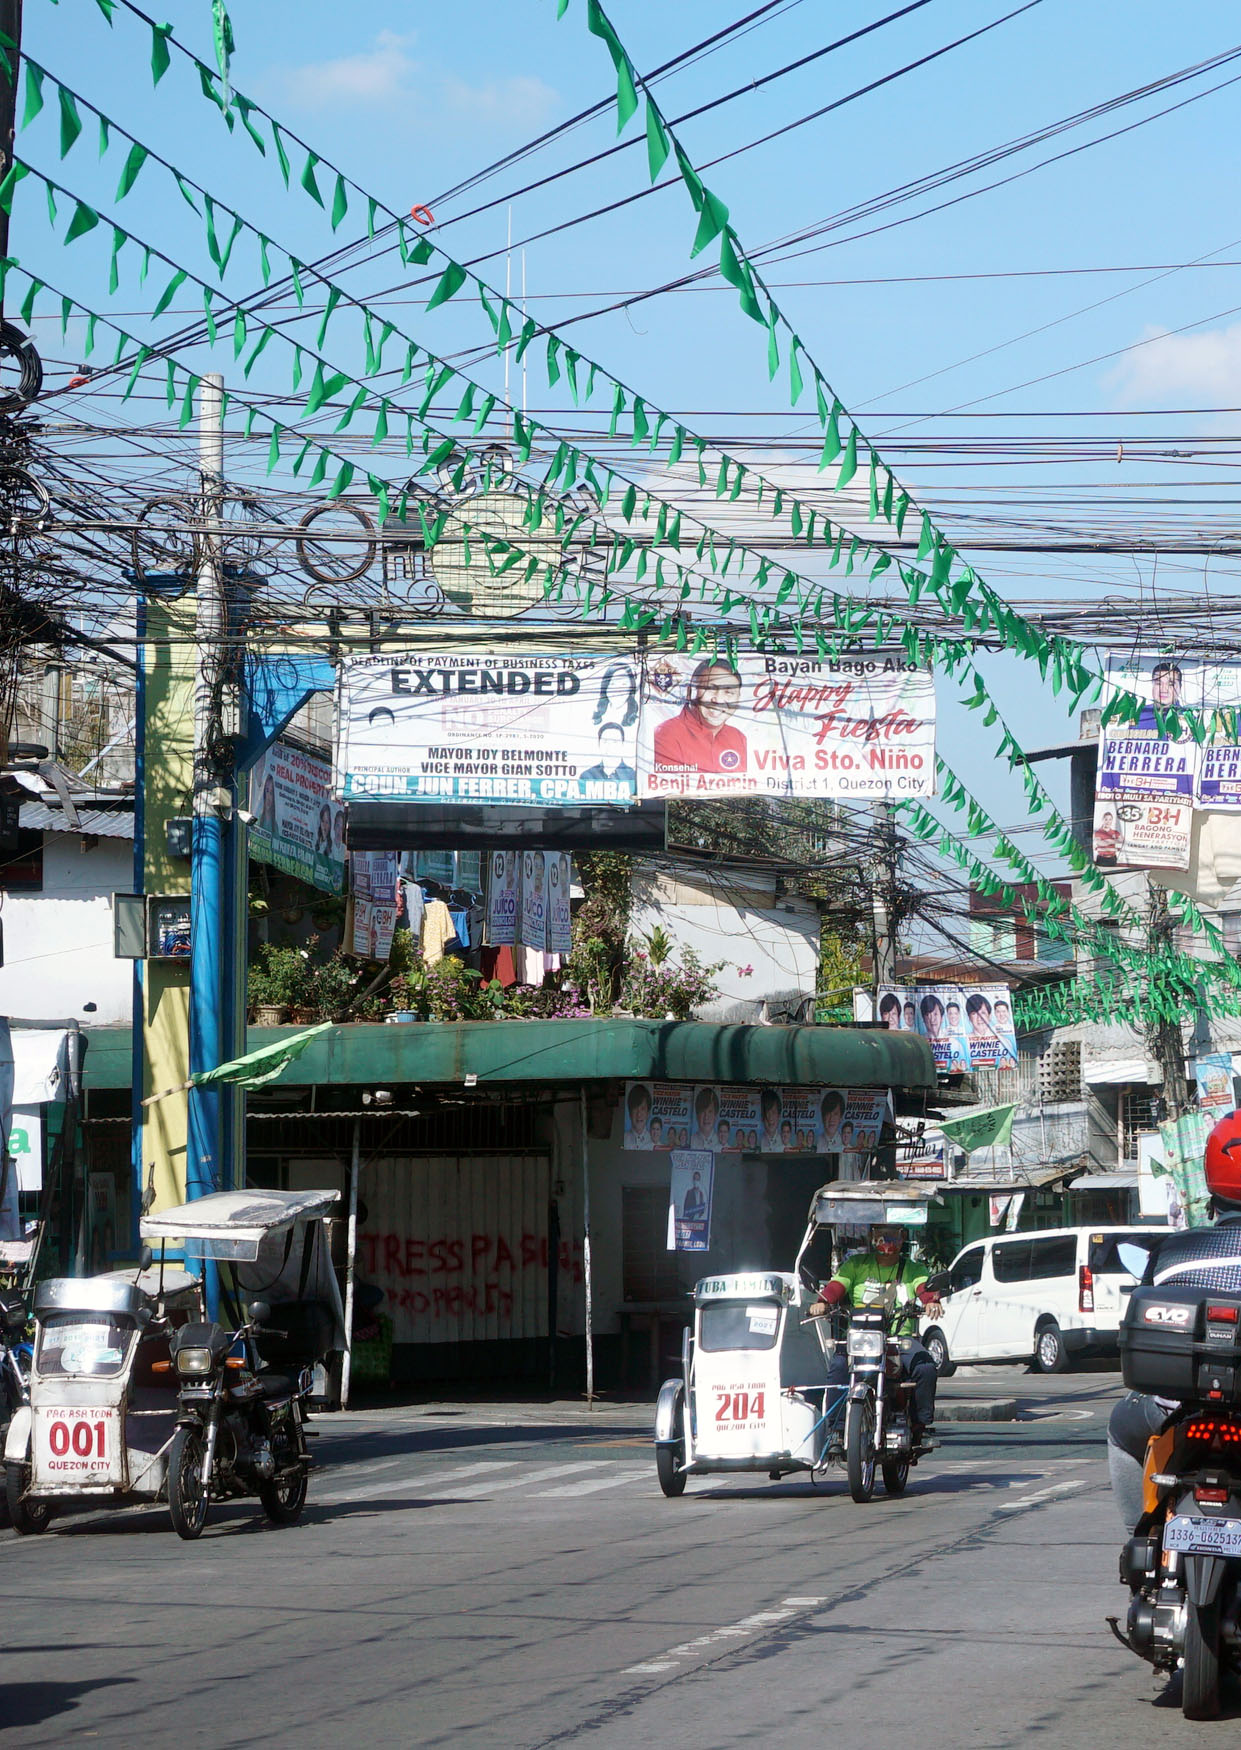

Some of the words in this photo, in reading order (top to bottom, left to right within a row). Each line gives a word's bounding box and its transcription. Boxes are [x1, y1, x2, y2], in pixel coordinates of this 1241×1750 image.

[411, 658, 422, 668] OF
[428, 657, 480, 668] PAYMENT
[485, 658, 499, 669] OF
[502, 659, 557, 670] BUSINESS
[562, 660, 596, 671] TAXES
[764, 658, 822, 677] Bayan
[829, 658, 878, 677] Bago
[882, 658, 918, 674] Ako
[391, 668, 580, 696] EXTENDED
[752, 678, 856, 713] Happy
[812, 708, 924, 746] Fiesta
[428, 748, 472, 760] MAYOR
[476, 748, 498, 760] JOY
[502, 750, 568, 762] BELMONTE
[1107, 740, 1170, 756] BERNARD
[754, 749, 806, 770] Viva
[814, 750, 862, 770] Sto.
[870, 748, 924, 770] Niño
[1105, 756, 1187, 774] HERRERA
[420, 762, 450, 774] VICE
[454, 762, 498, 776] MAYOR
[502, 763, 532, 776] GIAN
[536, 764, 577, 777] SOTTO
[654, 762, 699, 772] Konsehal
[350, 775, 412, 796] COUN.
[416, 777, 450, 796] JUN
[458, 778, 536, 799] FERRER,
[648, 774, 692, 794] Benji
[700, 775, 758, 792] Aromin
[838, 777, 893, 791] Quezon
[897, 776, 926, 792] City
[1122, 793, 1142, 801] MULI
[1148, 807, 1182, 826] BH
[1134, 824, 1172, 832] BAGONG
[1132, 832, 1188, 842] HENERASYON
[493, 898, 515, 914] JUICO
[969, 1040, 1000, 1050] WINNIE
[970, 1049, 1008, 1058] CASTELO
[652, 1096, 682, 1106] WINNIE
[720, 1100, 750, 1110] WINNIE
[782, 1100, 810, 1110] WINNIE
[846, 1102, 875, 1111] WINNIE
[652, 1106, 688, 1116] CASTELO
[720, 1110, 756, 1119] CASTELO
[782, 1110, 816, 1119] CASTELO
[844, 1111, 880, 1120] CASTELO
[1145, 1307, 1189, 1322] EVO
[716, 1392, 766, 1422] 204
[49, 1421, 106, 1458] 001
[48, 1461, 88, 1470] QUEZON
[90, 1461, 111, 1470] CITY
